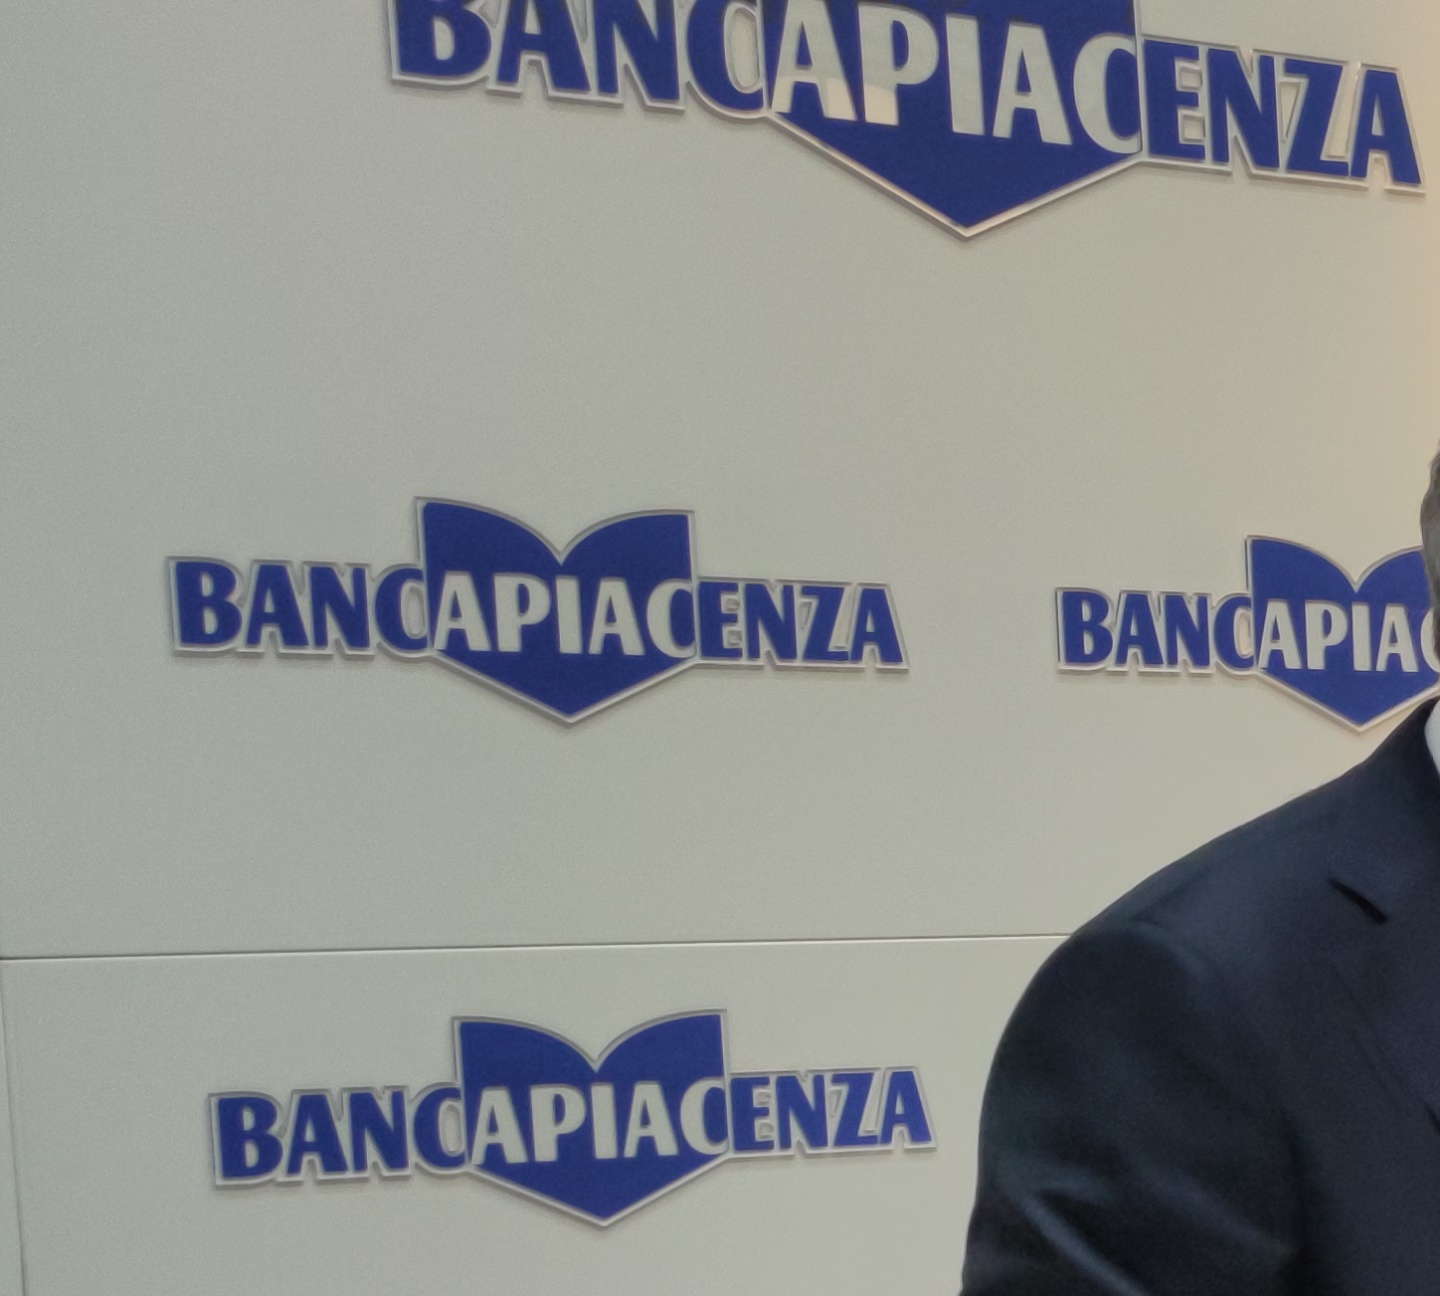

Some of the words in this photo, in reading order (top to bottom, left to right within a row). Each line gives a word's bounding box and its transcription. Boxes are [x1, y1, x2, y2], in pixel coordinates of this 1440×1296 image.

[398, 0, 1422, 185] BANCAPIACENZA
[173, 558, 903, 666] BANCAPIACENZA
[1062, 590, 1440, 674] BANCAPIA
[216, 1069, 934, 1183] BANCAPIACENZA
